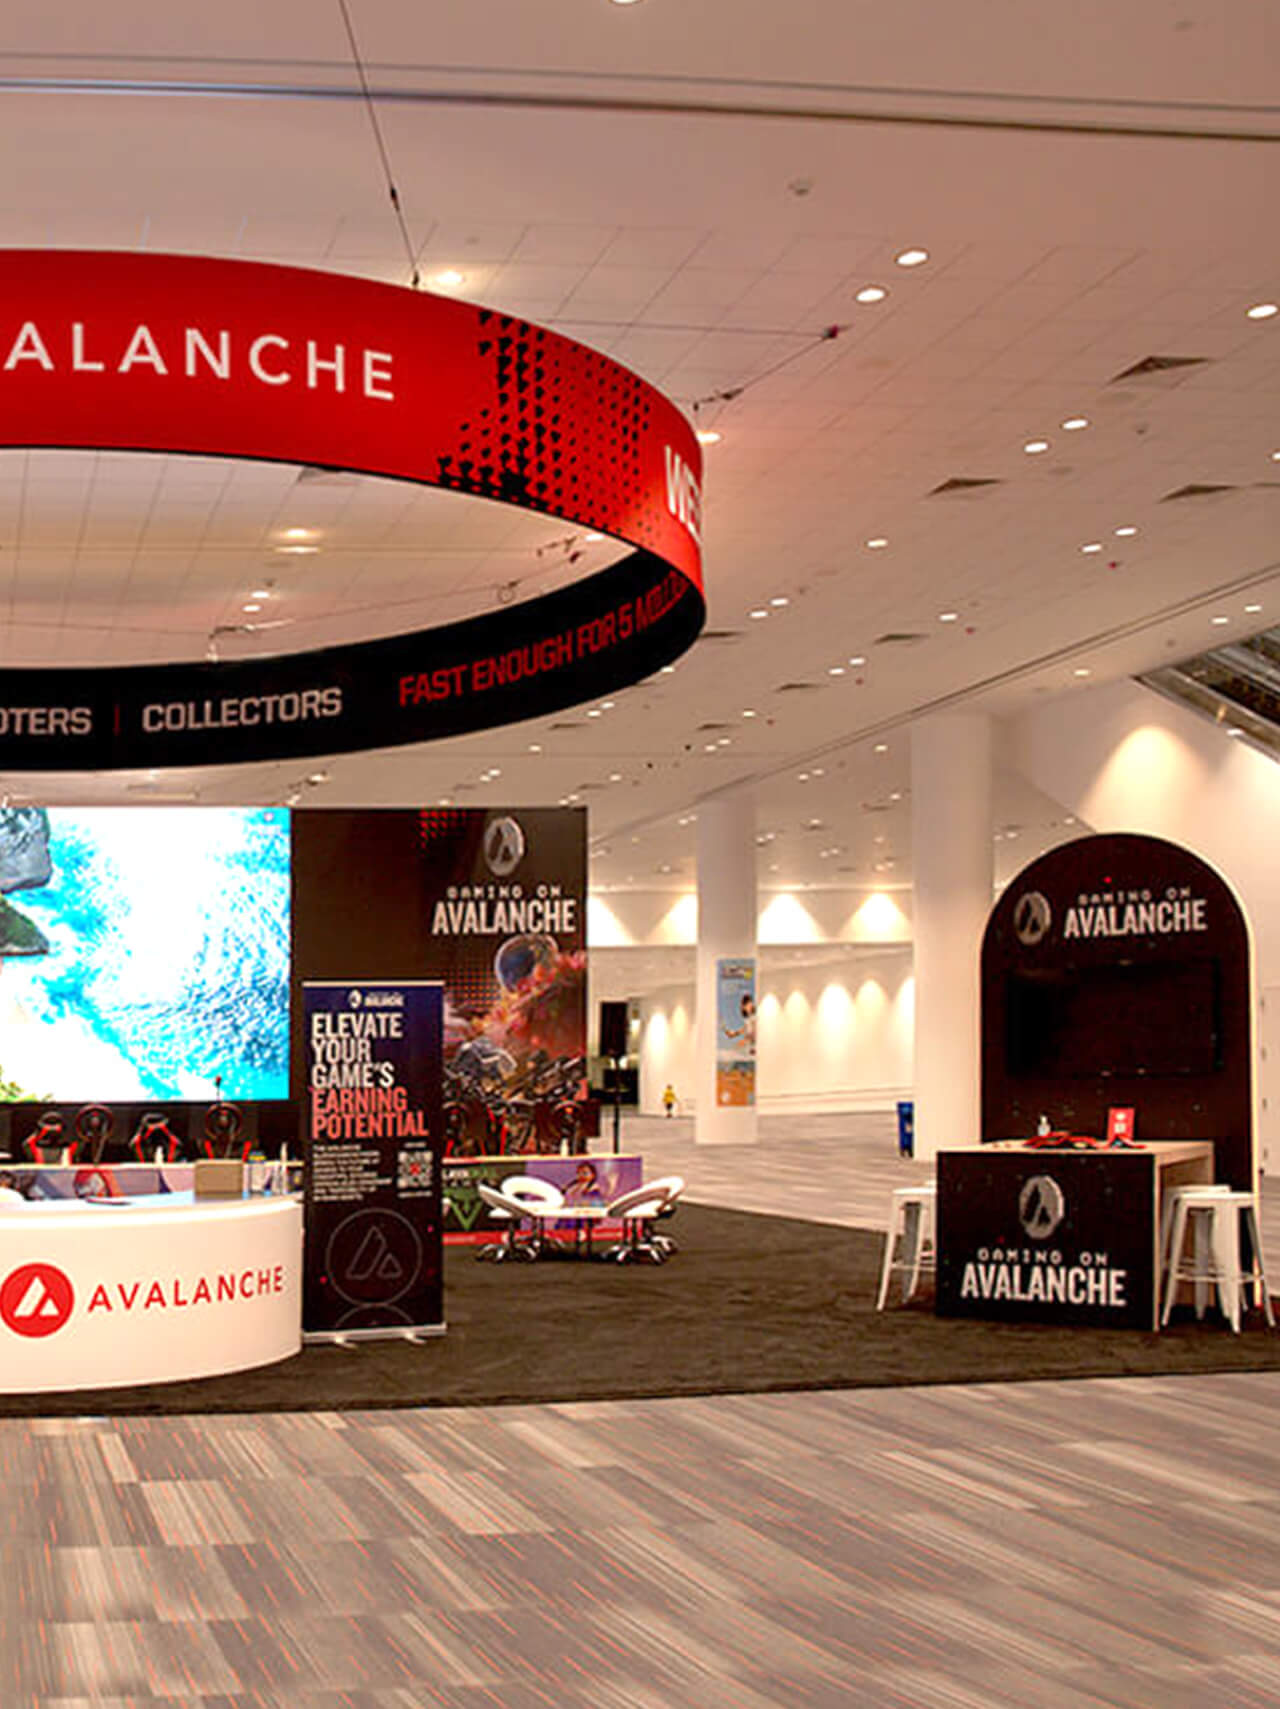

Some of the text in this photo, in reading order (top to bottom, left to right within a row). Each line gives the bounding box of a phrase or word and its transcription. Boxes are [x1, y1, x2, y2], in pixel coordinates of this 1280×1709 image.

[399, 665, 467, 706] FAST
[471, 631, 572, 692] ENOUGH
[577, 611, 617, 657] FOR
[618, 602, 633, 638] 5
[142, 687, 343, 732] COLLECTORS
[431, 899, 577, 935] AVALANCHE
[1064, 899, 1208, 938] AVALANCHE
[312, 1012, 404, 1039] ELEVATE
[311, 1038, 372, 1065] YOUR
[311, 1061, 394, 1089] GAME'S
[312, 1086, 408, 1114] EARNING
[312, 1110, 429, 1139] POTENTIAL
[87, 1265, 283, 1314] AVALANCHE
[960, 1261, 1127, 1307] AVALANCHE
